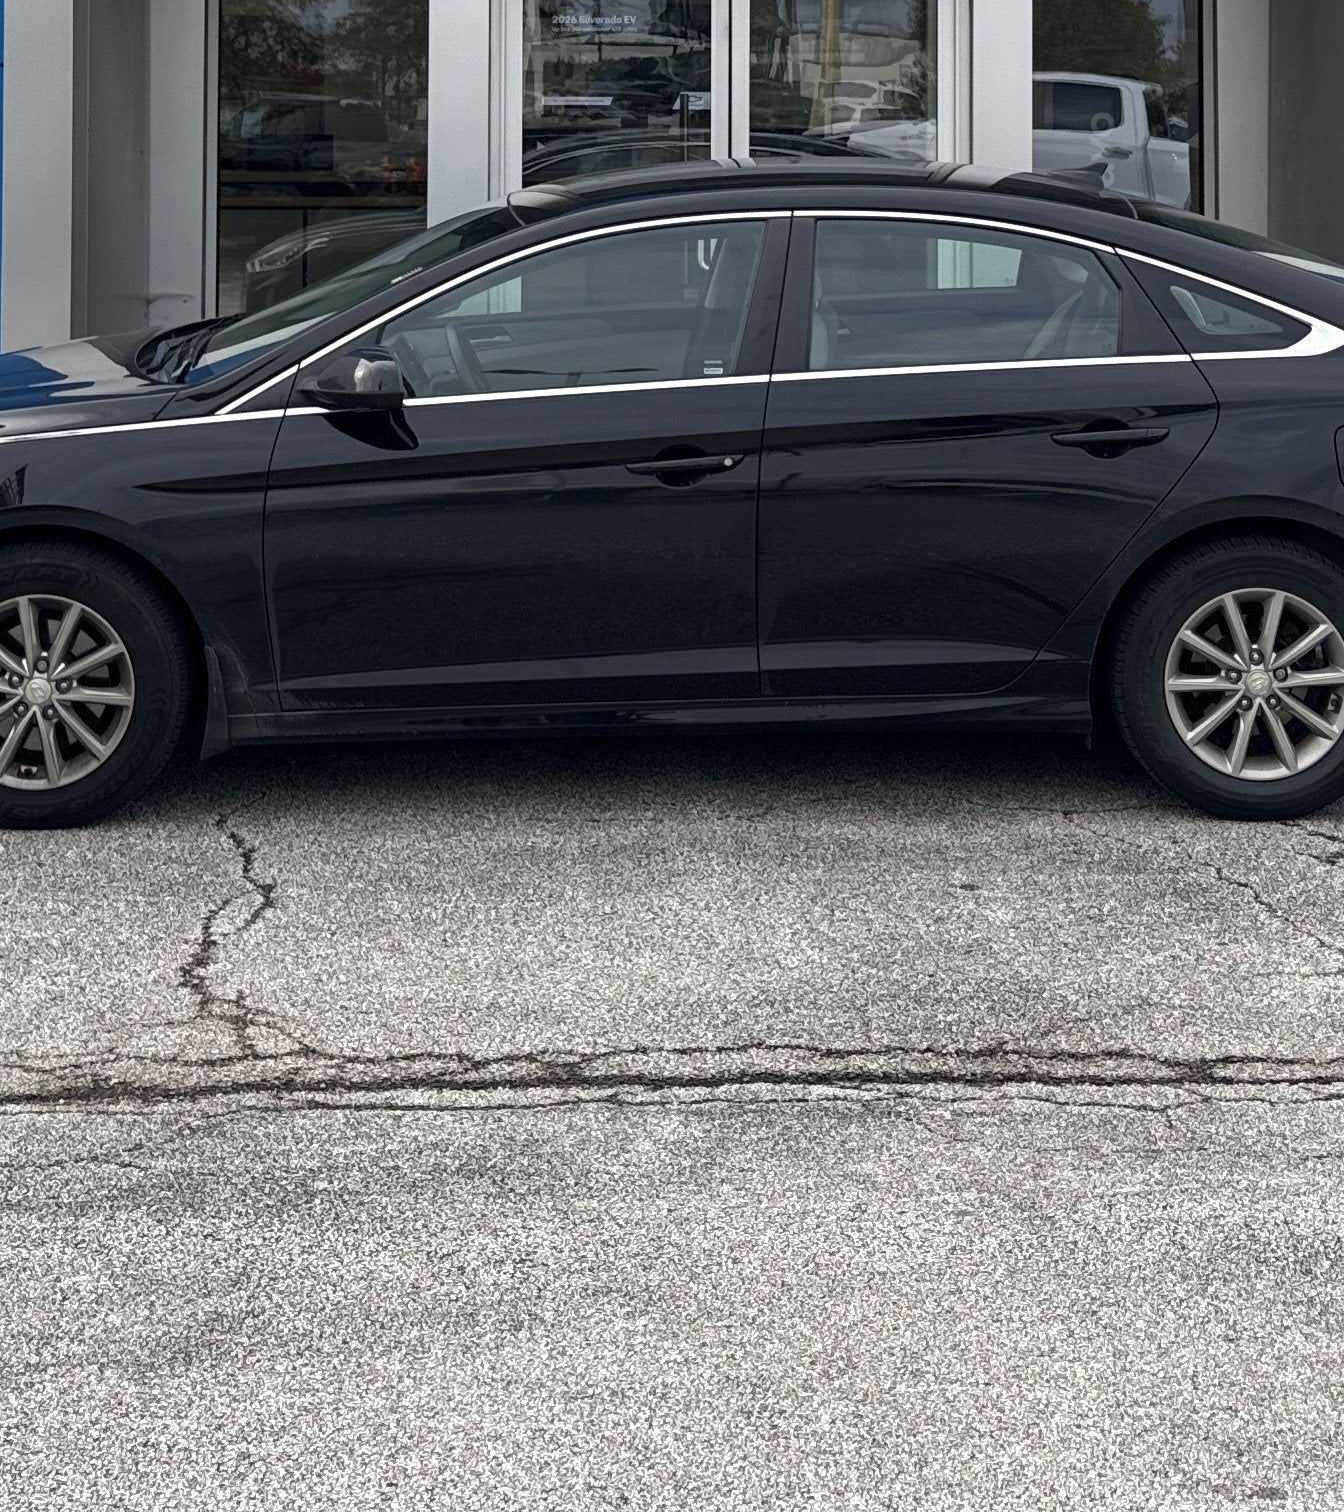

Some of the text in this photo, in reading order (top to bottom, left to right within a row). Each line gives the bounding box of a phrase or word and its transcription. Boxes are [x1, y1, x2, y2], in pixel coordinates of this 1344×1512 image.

[552, 13, 637, 24] 2026 Silverado EV
